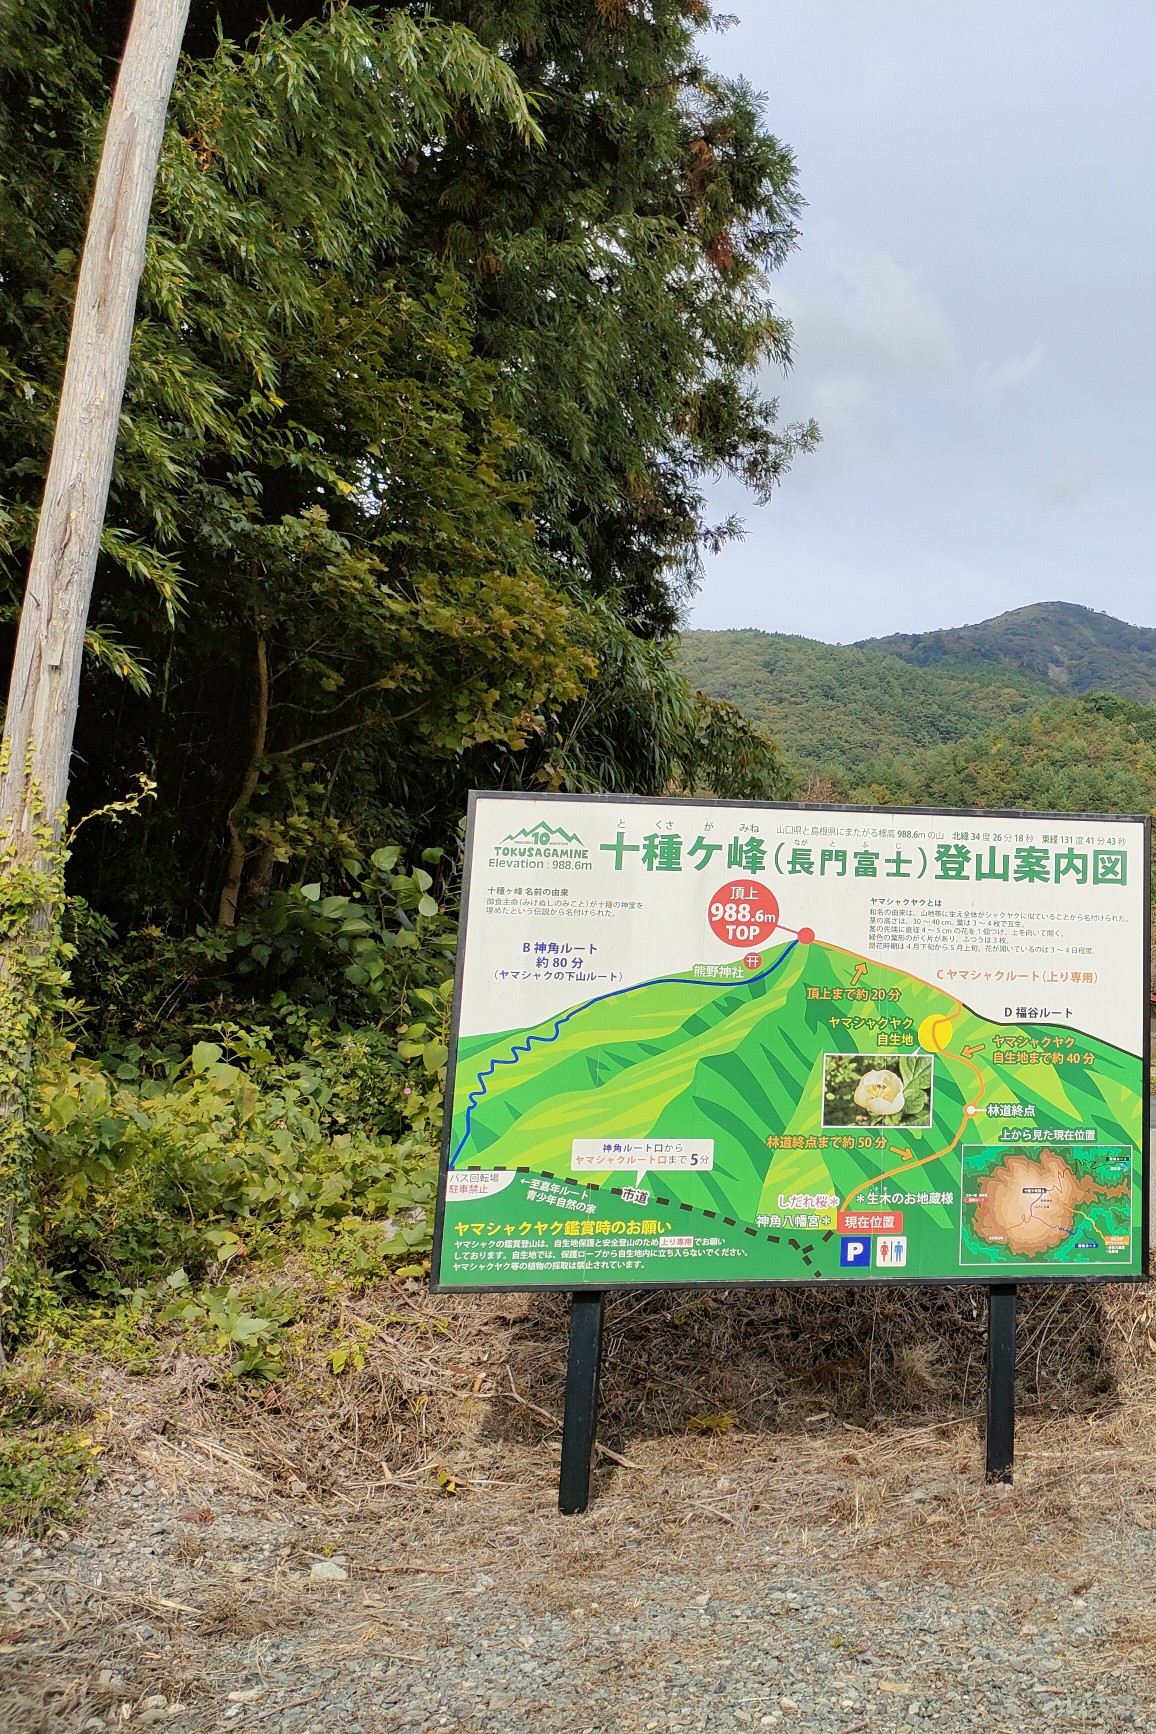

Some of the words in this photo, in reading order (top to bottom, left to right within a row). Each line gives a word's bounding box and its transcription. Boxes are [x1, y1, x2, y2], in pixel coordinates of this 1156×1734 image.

[617, 818, 626, 829] と
[655, 820, 675, 830] くさ
[703, 821, 714, 832] が
[739, 823, 760, 833] みね
[532, 831, 550, 846] 10
[494, 846, 589, 859] TOKUSAGAMINE
[488, 858, 544, 869] Elevation
[552, 861, 592, 870] 988.6m
[730, 886, 759, 900] 頂上
[870, 897, 943, 907] ヤマシャクヤクとは
[711, 902, 776, 923] 988.6m
[725, 925, 760, 941] TOP
[522, 942, 531, 953] B
[534, 942, 598, 954] 神角ルート
[693, 965, 744, 978] 熊野神社
[936, 969, 944, 980] C
[1004, 1007, 1013, 1017] D
[1015, 1007, 1073, 1019] 福谷ルート
[828, 1016, 914, 1029] ヤマシャクヤク
[877, 1033, 914, 1047] 自生地
[993, 1036, 1075, 1049] ヤマシャクヤク
[987, 1104, 1036, 1117] 林道終点
[1000, 1129, 1096, 1141] 上から見た現在位置
[602, 1143, 683, 1153] 神角ルート口から
[449, 1173, 500, 1183] バス回転場
[448, 1184, 489, 1194] 駐車禁止
[528, 1178, 589, 1200] 至嘉年ルート
[526, 1190, 597, 1214] 青少年自然の家
[622, 1187, 648, 1205] 市道
[778, 1194, 829, 1209] しだれ桜
[866, 1192, 954, 1205] 生木のお地蔵様
[756, 1214, 820, 1228] 神角八幡宮
[844, 1216, 895, 1229] 現在位置
[454, 1220, 672, 1237] ヤマシャクヤク鑑賞時のお願い
[847, 1242, 864, 1262] P
